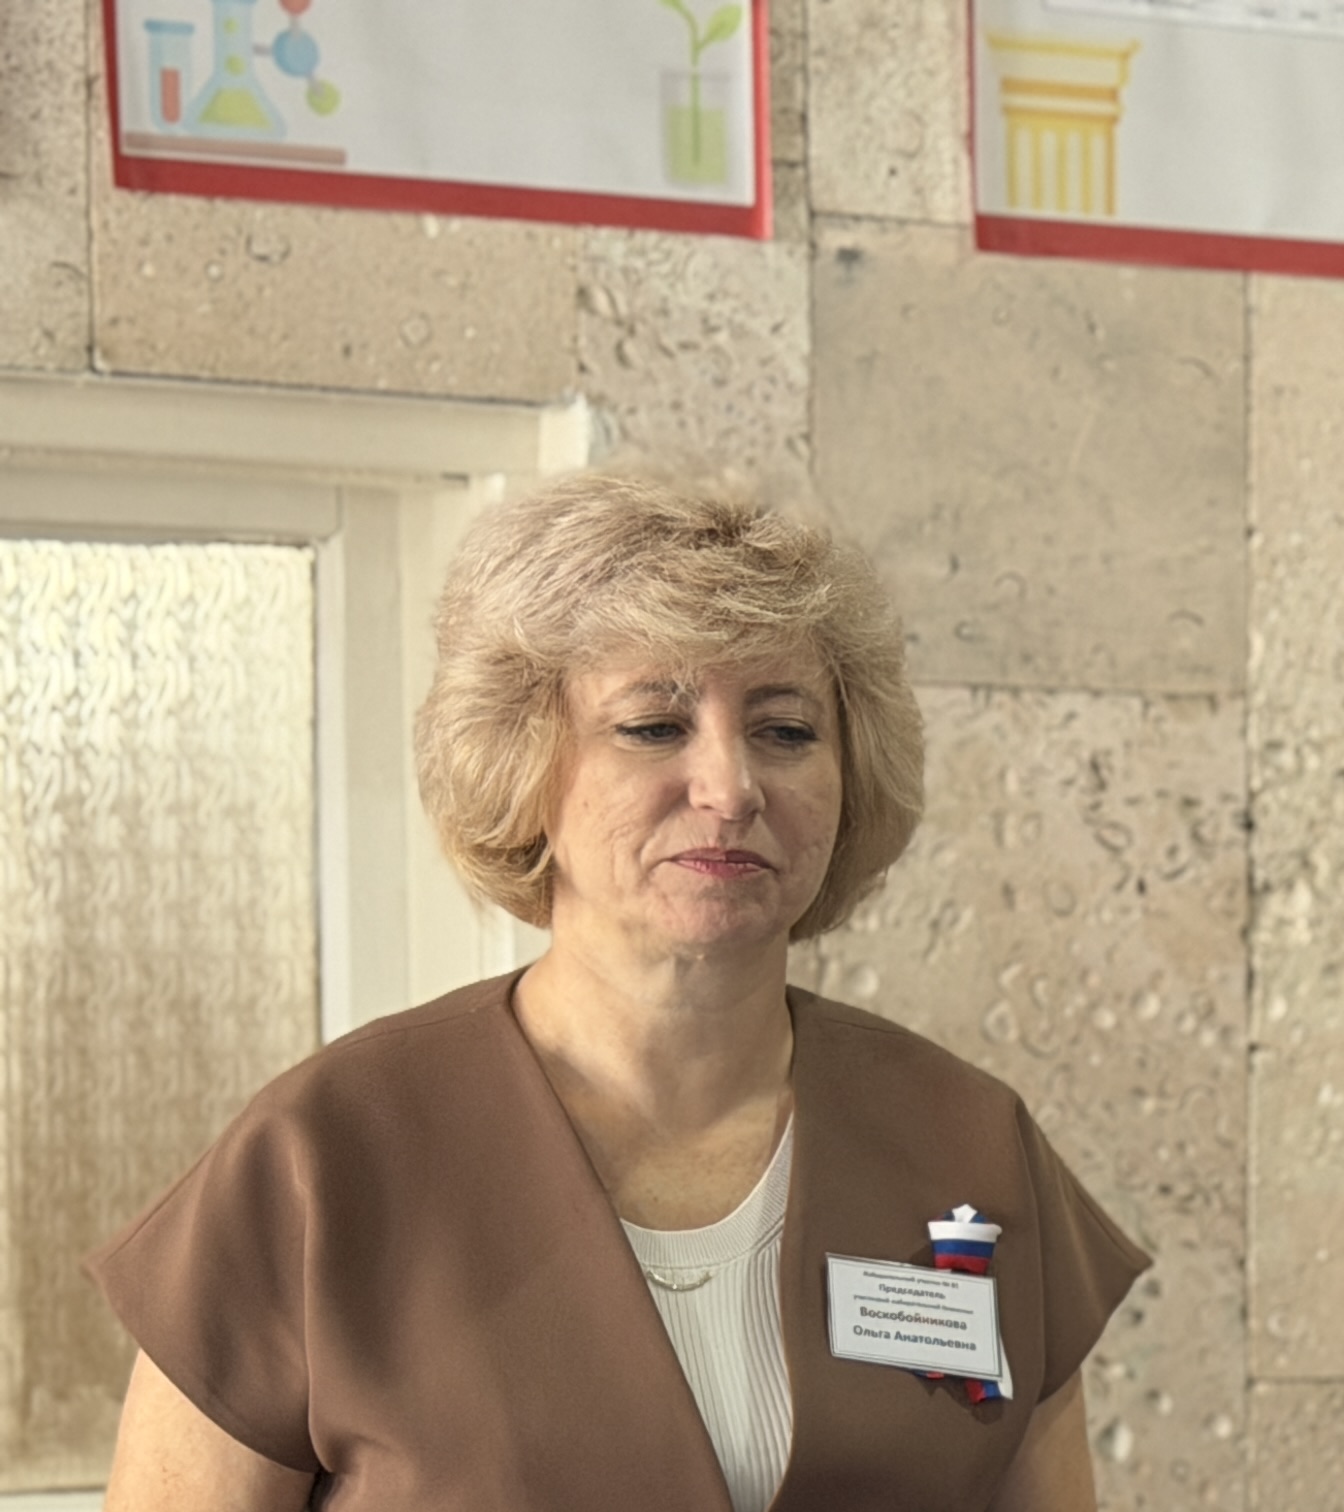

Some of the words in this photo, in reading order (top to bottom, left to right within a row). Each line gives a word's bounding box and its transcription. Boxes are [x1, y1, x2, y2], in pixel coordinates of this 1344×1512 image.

[879, 1283, 946, 1300] Председатель
[860, 1306, 967, 1331] Воскобойникова
[853, 1325, 891, 1340] Ольга
[894, 1331, 977, 1351] Анатольевна
